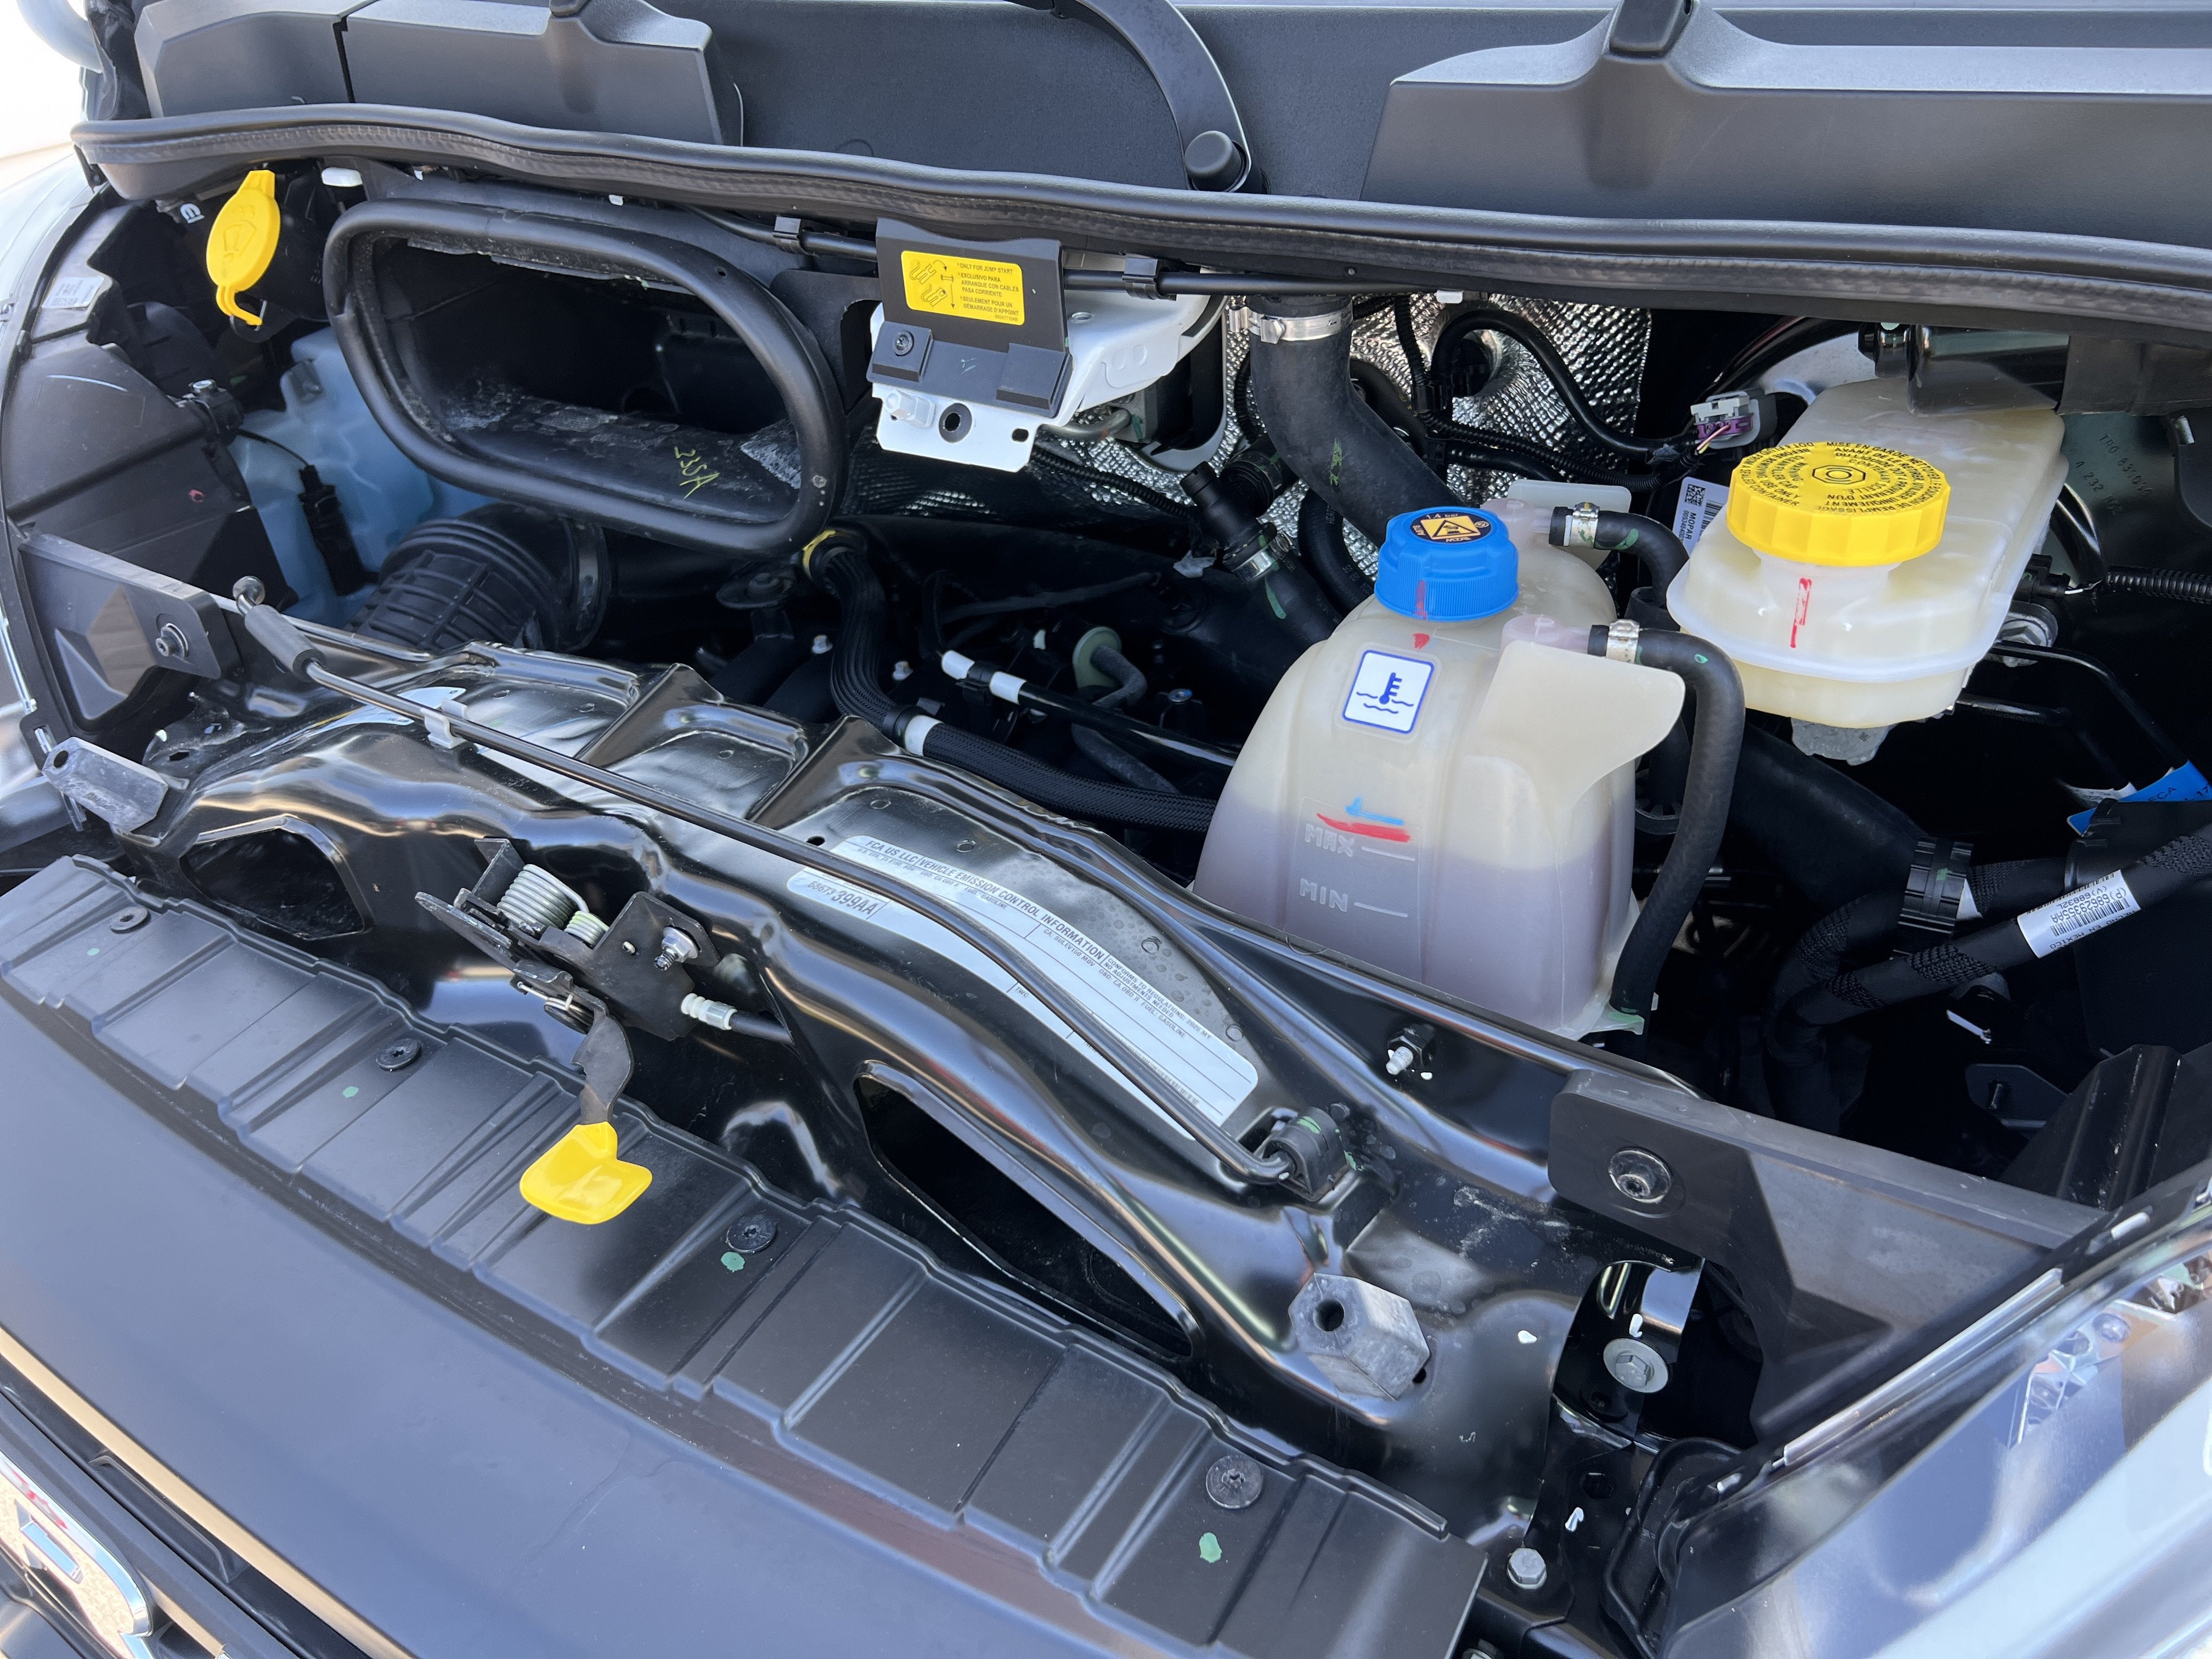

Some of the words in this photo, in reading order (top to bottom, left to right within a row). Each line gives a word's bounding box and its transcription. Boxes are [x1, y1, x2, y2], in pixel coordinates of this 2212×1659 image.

[961, 273, 987, 281] EXCLUSIVO
[961, 280, 987, 289] ARRANQUE
[963, 296, 990, 305] SEULEMENT
[975, 289, 1002, 297] CORRIENTE
[963, 303, 993, 313] DÉMARRAGE
[1759, 446, 1786, 456] FLUID
[1772, 448, 1811, 459] BEFORE
[1744, 454, 1763, 466] FROM
[1778, 455, 1804, 466] CLEAN
[1854, 454, 1894, 467] LIQUIDE
[1740, 469, 1756, 484] SEALED
[1771, 466, 1786, 481] FILLER
[1849, 460, 1891, 483] CONTENANT
[1889, 468, 1907, 477] DOT
[1760, 479, 1778, 489] USE
[1779, 481, 1798, 489] CAP
[1859, 481, 1908, 500] PROVENANT
[1900, 482, 1925, 500] UTILISER
[1750, 485, 1800, 506] CONTAINER
[1774, 488, 1801, 499] ONLY
[1910, 486, 1941, 505] BOUCHON
[1816, 505, 1897, 514] REMPLISSAGE
[1826, 497, 1900, 507] UNIQUEMENT
[1685, 512, 1697, 540] MOPAR
[1304, 823, 1355, 857] MAX
[866, 840, 885, 851] FCA
[885, 847, 900, 856] US
[899, 852, 919, 863] LLC
[964, 887, 981, 895] FUEL:
[981, 894, 1009, 910] GASOLINE
[1299, 878, 1348, 912] MIN
[2057, 885, 2107, 910] (V)68832L
[919, 859, 957, 877] VEHICLE
[955, 872, 1000, 894] EMISSION
[998, 890, 1040, 917] CONTROL
[1041, 914, 1105, 960] INFORMATION
[2050, 887, 2127, 924] (P)68629355AA
[1043, 929, 1053, 937] CA:
[1081, 956, 1096, 967] MDV
[1099, 968, 1113, 980] OBD:
[1113, 980, 1121, 988] CA
[1121, 986, 1135, 997] OBD
[1141, 1001, 1158, 1015] FUEL:
[1158, 1015, 1187, 1038] GASOLINE
[1103, 962, 1113, 970] NO
[1113, 967, 1152, 1001] ADJUSTMENTS
[1152, 1000, 1174, 1018] NEEDED
[1108, 958, 1138, 983] CONFORMS
[1138, 981, 1147, 990] TO
[1201, 1029, 1212, 1039] MY
